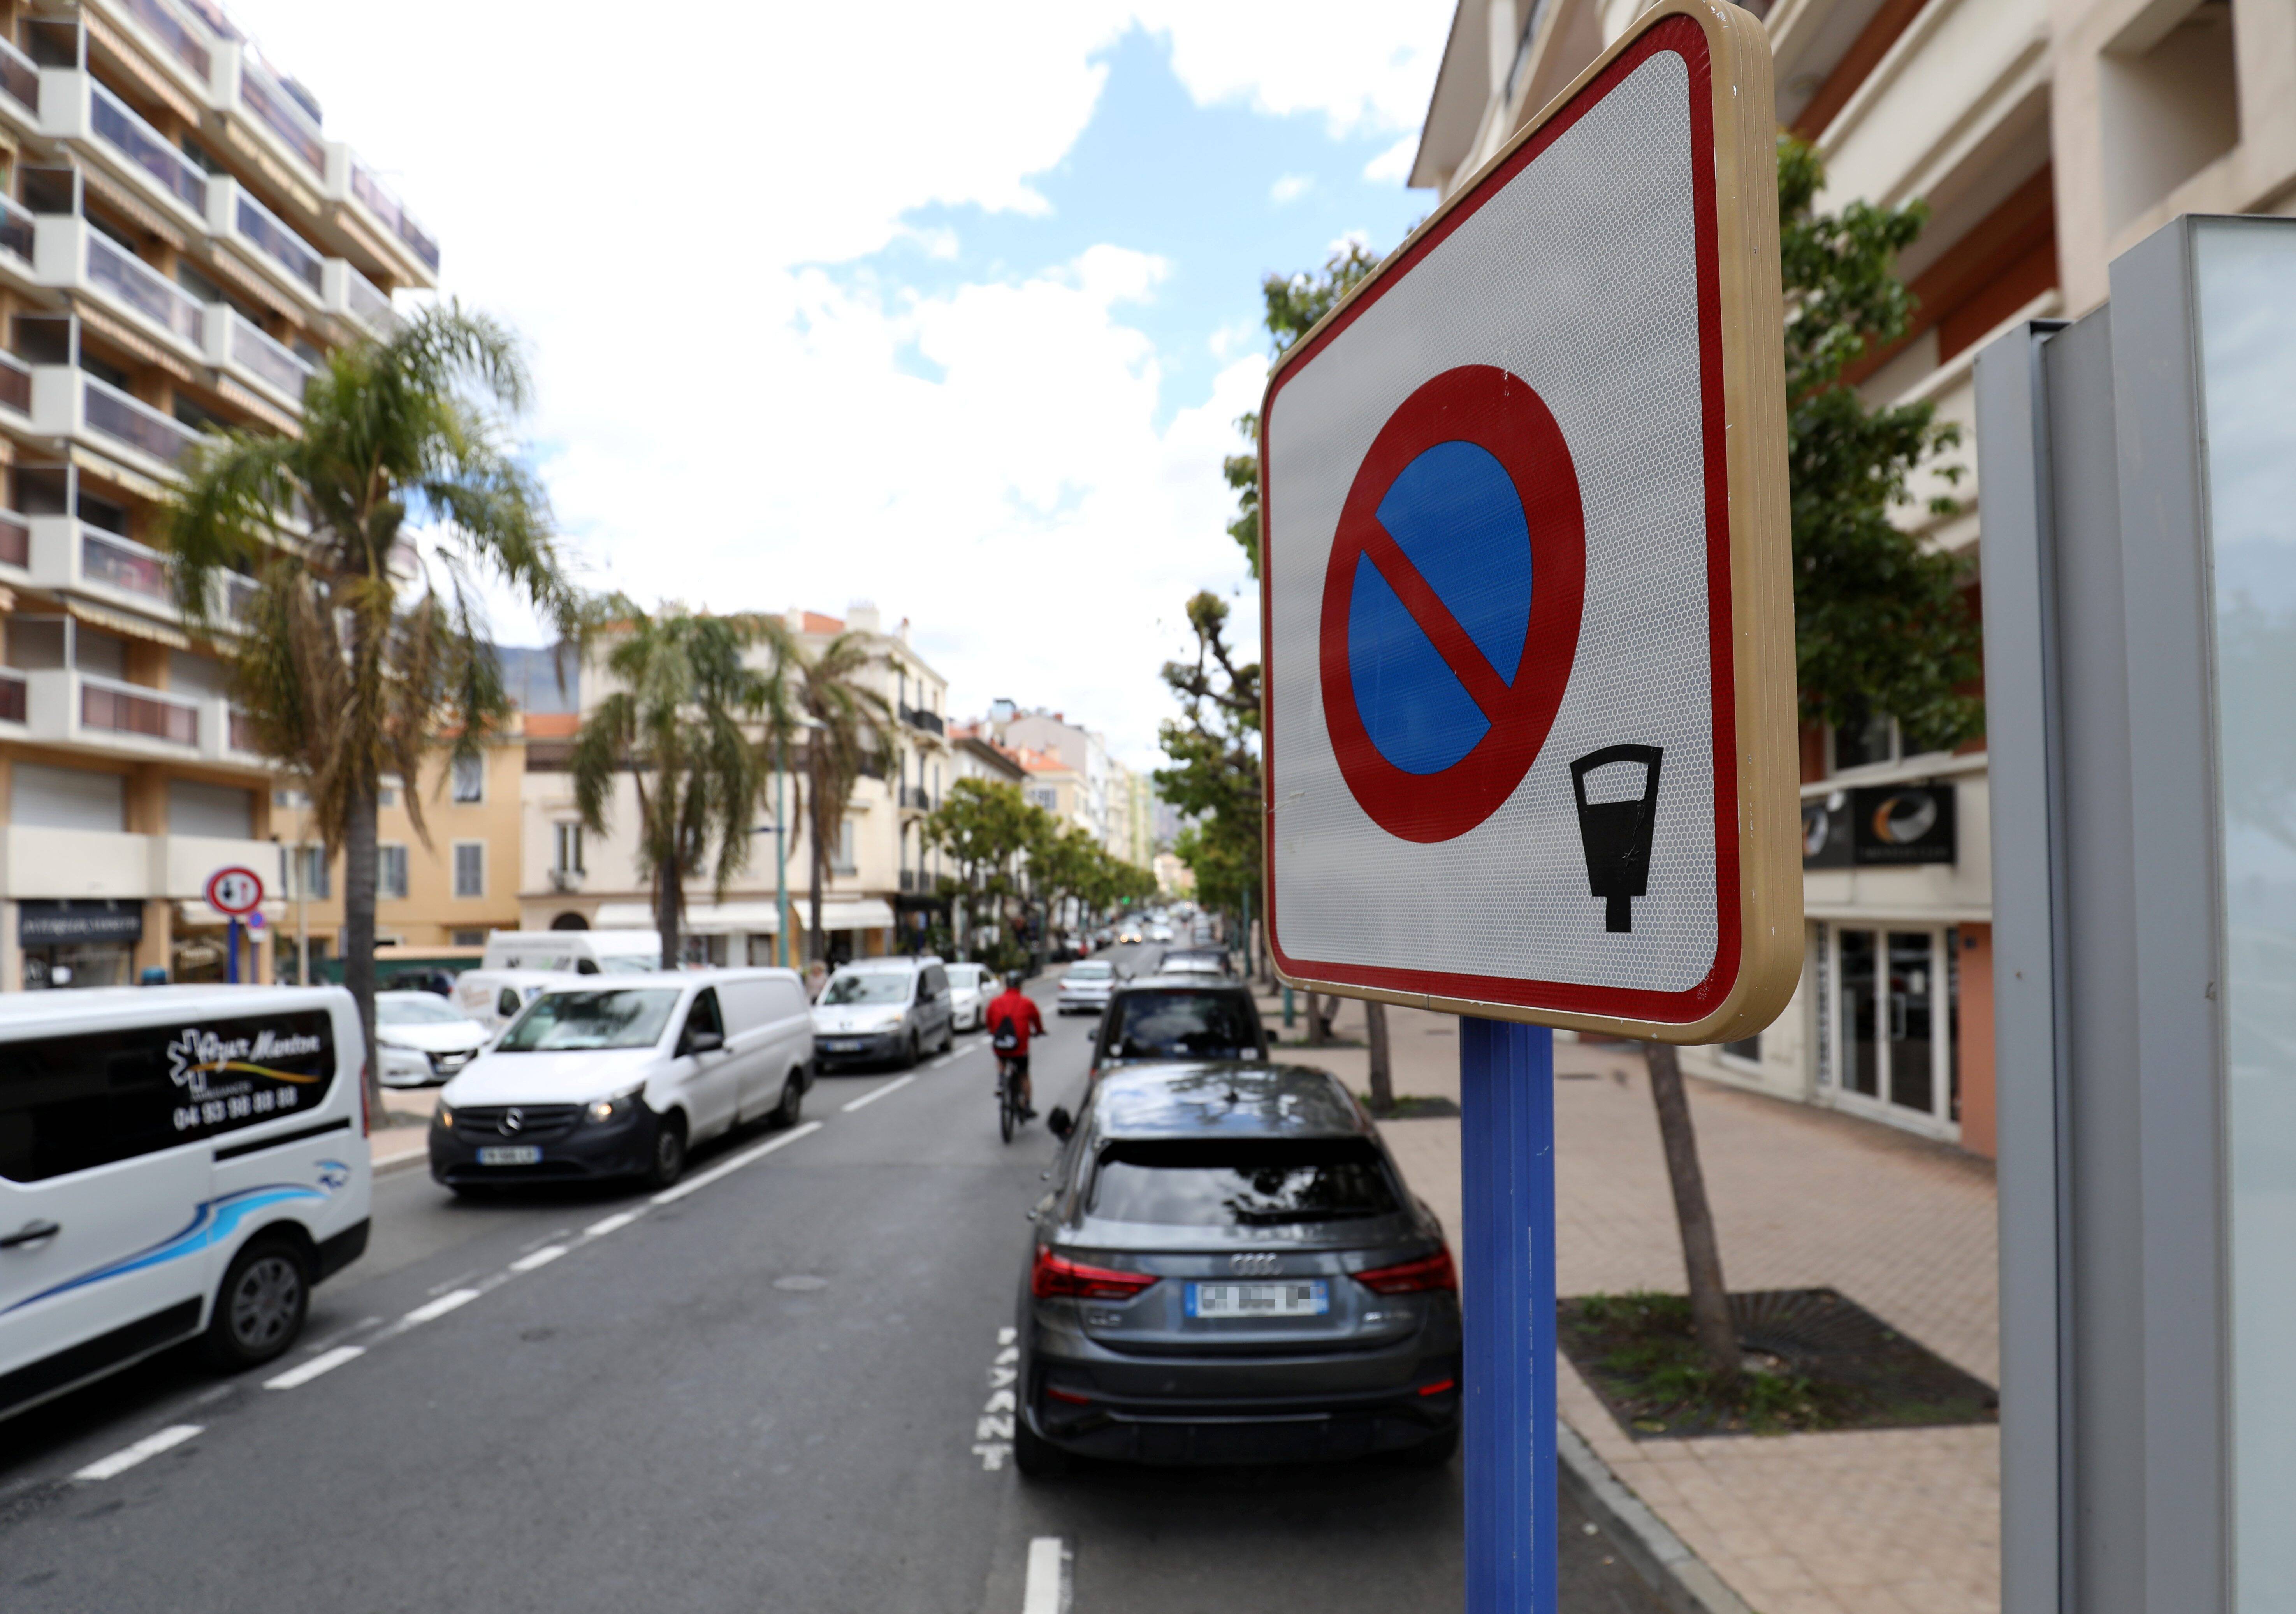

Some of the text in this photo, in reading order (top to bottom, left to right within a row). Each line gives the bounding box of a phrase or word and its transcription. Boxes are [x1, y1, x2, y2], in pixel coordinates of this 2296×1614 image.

[248, 1029, 320, 1062] Menton
[173, 1106, 202, 1131] 04
[201, 1099, 227, 1125] 93
